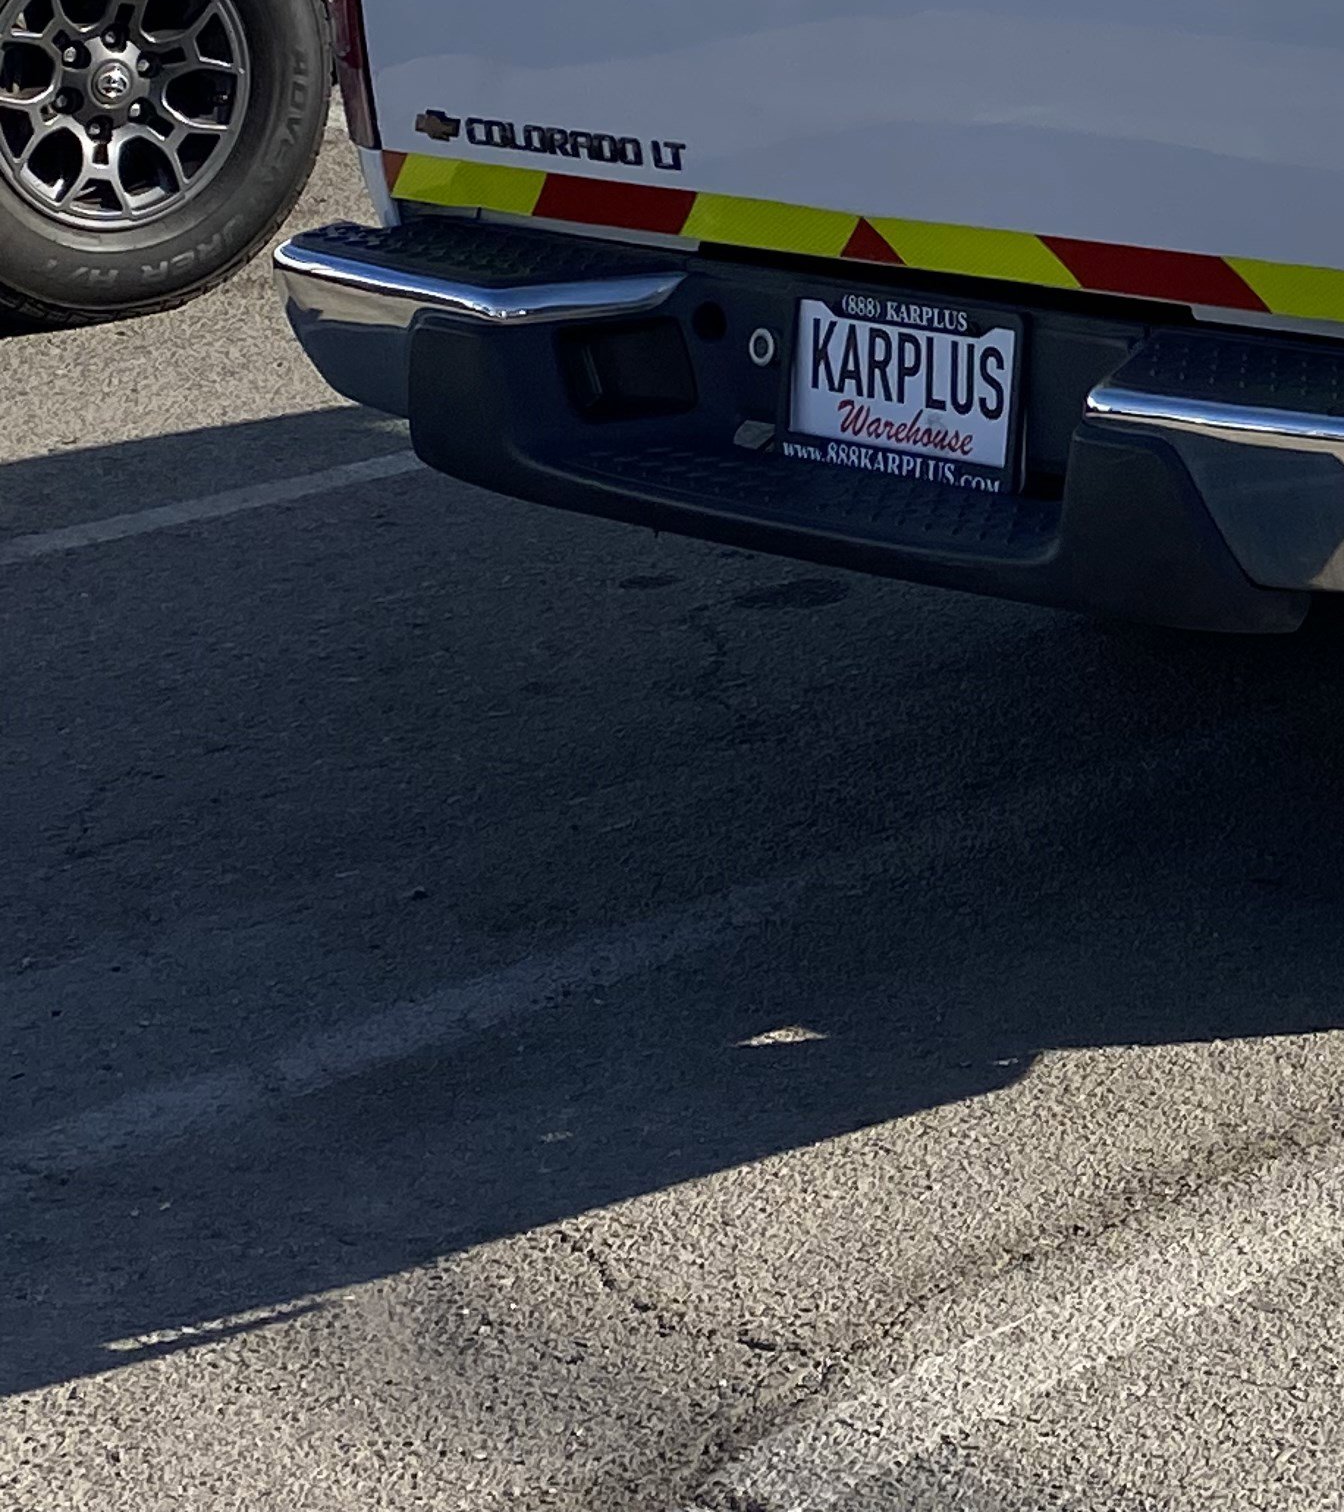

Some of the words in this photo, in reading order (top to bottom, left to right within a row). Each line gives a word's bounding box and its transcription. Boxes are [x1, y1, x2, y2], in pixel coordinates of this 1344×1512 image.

[465, 117, 643, 166] COLORADO
[651, 139, 686, 171] LT
[842, 294, 880, 318] (888)
[886, 300, 967, 332] KARPLUS
[811, 317, 1004, 421] KARPLUS
[837, 399, 973, 456] Warehouse
